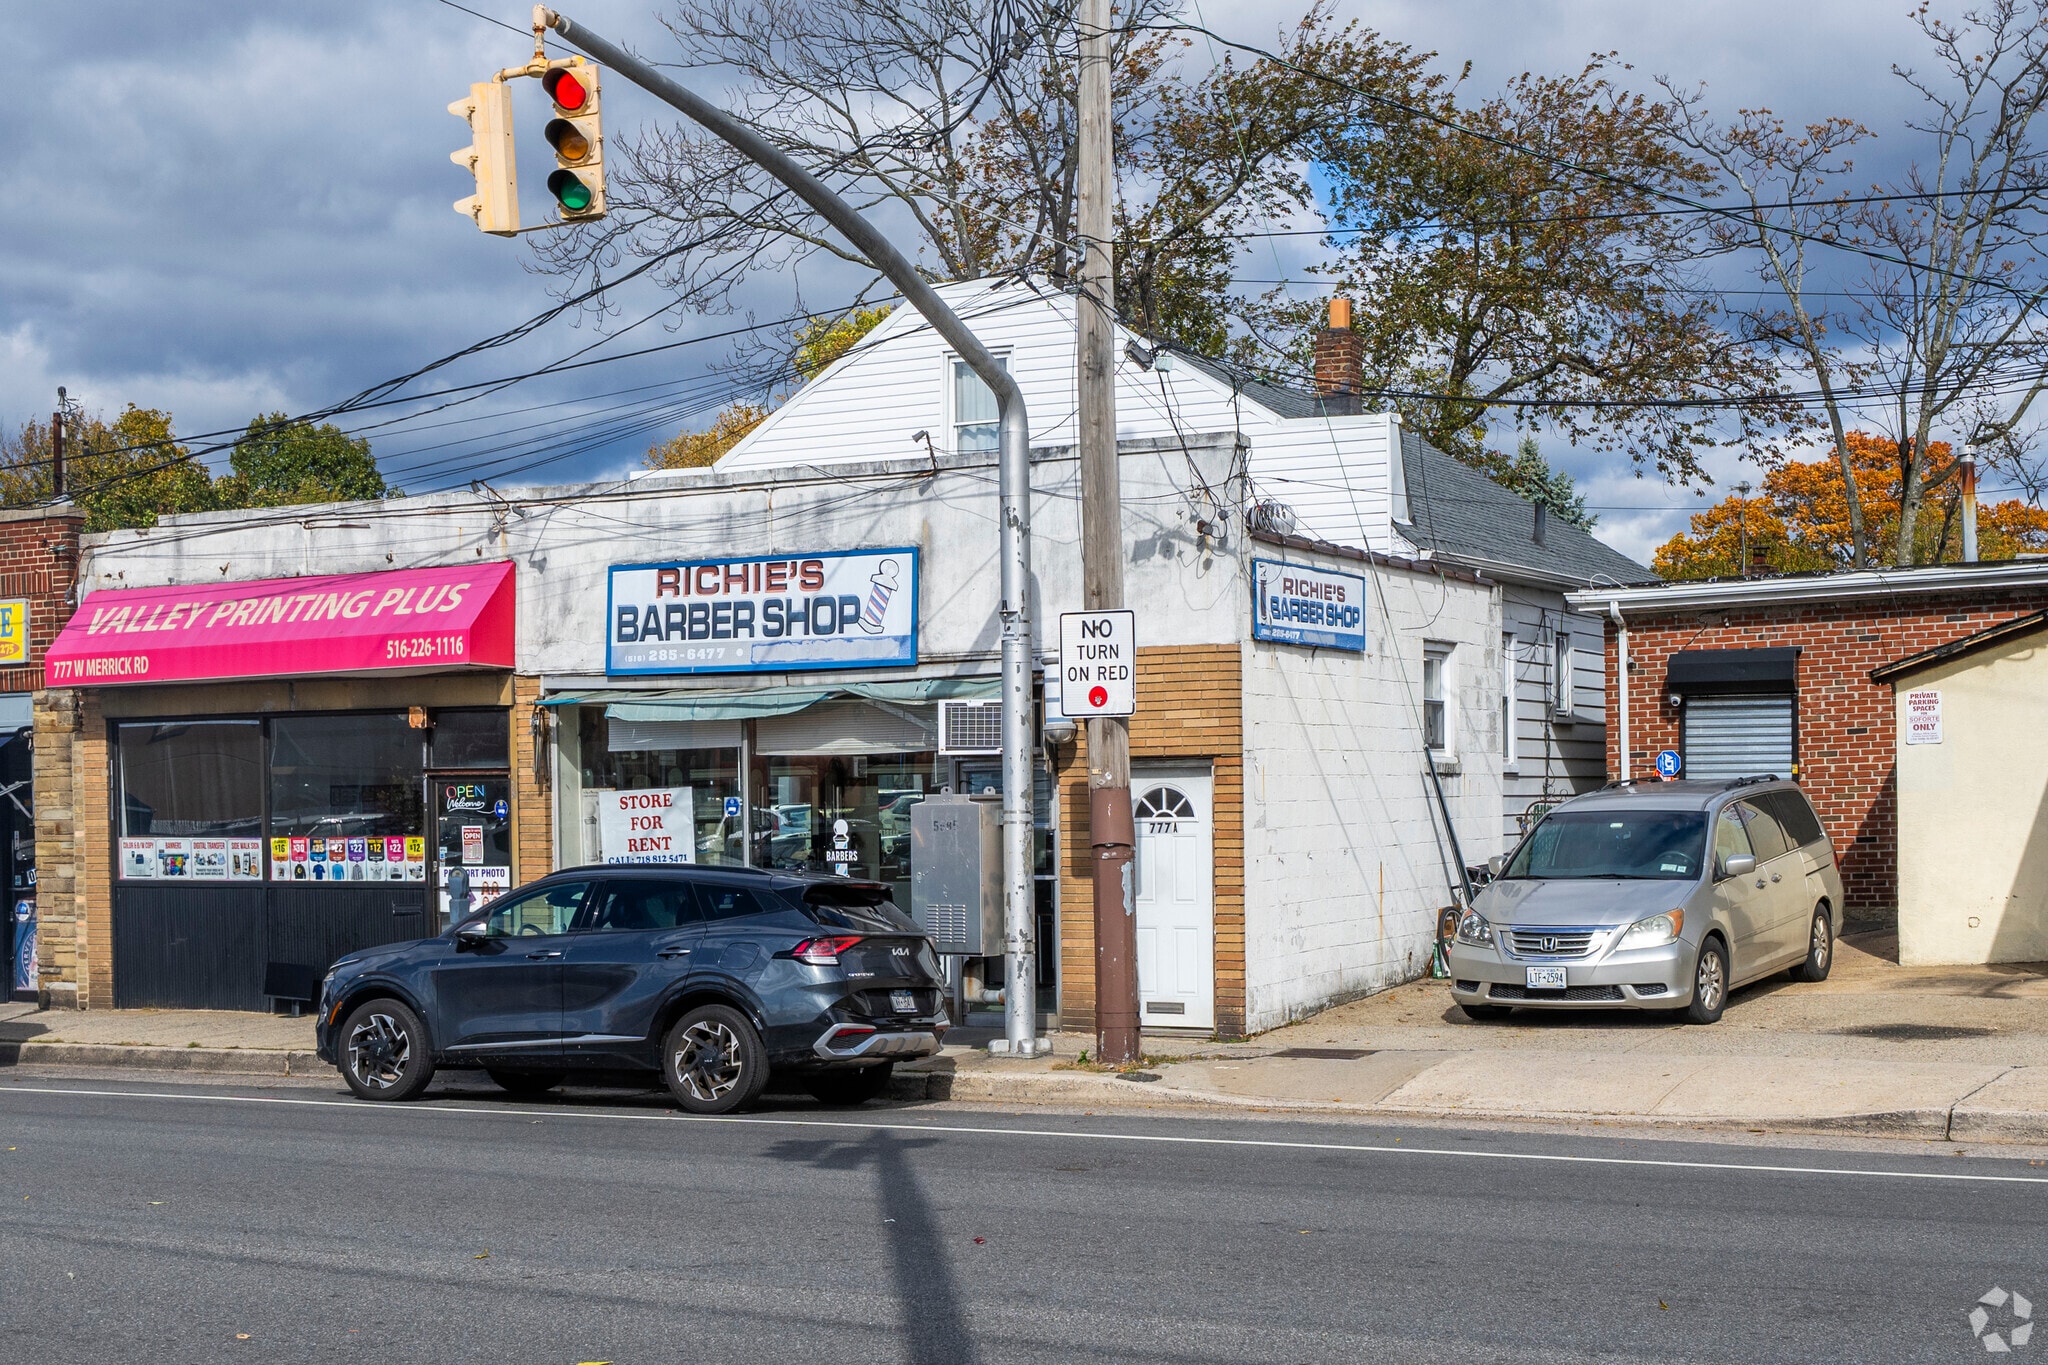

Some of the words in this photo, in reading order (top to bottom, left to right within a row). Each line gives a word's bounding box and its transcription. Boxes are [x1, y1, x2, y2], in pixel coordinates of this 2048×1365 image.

[656, 560, 825, 599] RICHIE'S
[1283, 577, 1346, 602] RICHIE'S
[87, 601, 213, 635] VALLEY
[206, 590, 376, 629] PRINTING
[371, 583, 471, 617] PLUS
[1270, 595, 1324, 626] BARBER
[1326, 602, 1360, 629] SHOP
[617, 600, 756, 643] BARBER
[762, 595, 862, 638] SHOP
[1081, 618, 1113, 639] NO
[386, 636, 464, 659] 516-226-1116
[648, 647, 726, 662] 285-6477
[1077, 644, 1119, 660] TURN
[53, 660, 72, 679] 777
[73, 659, 85, 678] W
[86, 656, 132, 676] MERRICK
[134, 655, 149, 674] RD
[1068, 666, 1089, 682] ON
[1098, 665, 1129, 681] RED
[1908, 698, 1939, 706] PARKING
[1912, 723, 1936, 731] ONLY
[446, 785, 485, 798] OPEN
[620, 793, 673, 810] STORE
[630, 815, 664, 831] FOR
[350, 844, 363, 852] $22
[370, 844, 381, 852] $12
[390, 844, 402, 852] $22
[628, 836, 672, 852] RENT
[636, 855, 651, 864] 718
[652, 854, 667, 863] 812
[668, 853, 688, 863] 5471
[826, 850, 858, 862] BARBERS
[481, 868, 505, 878] PHOTO
